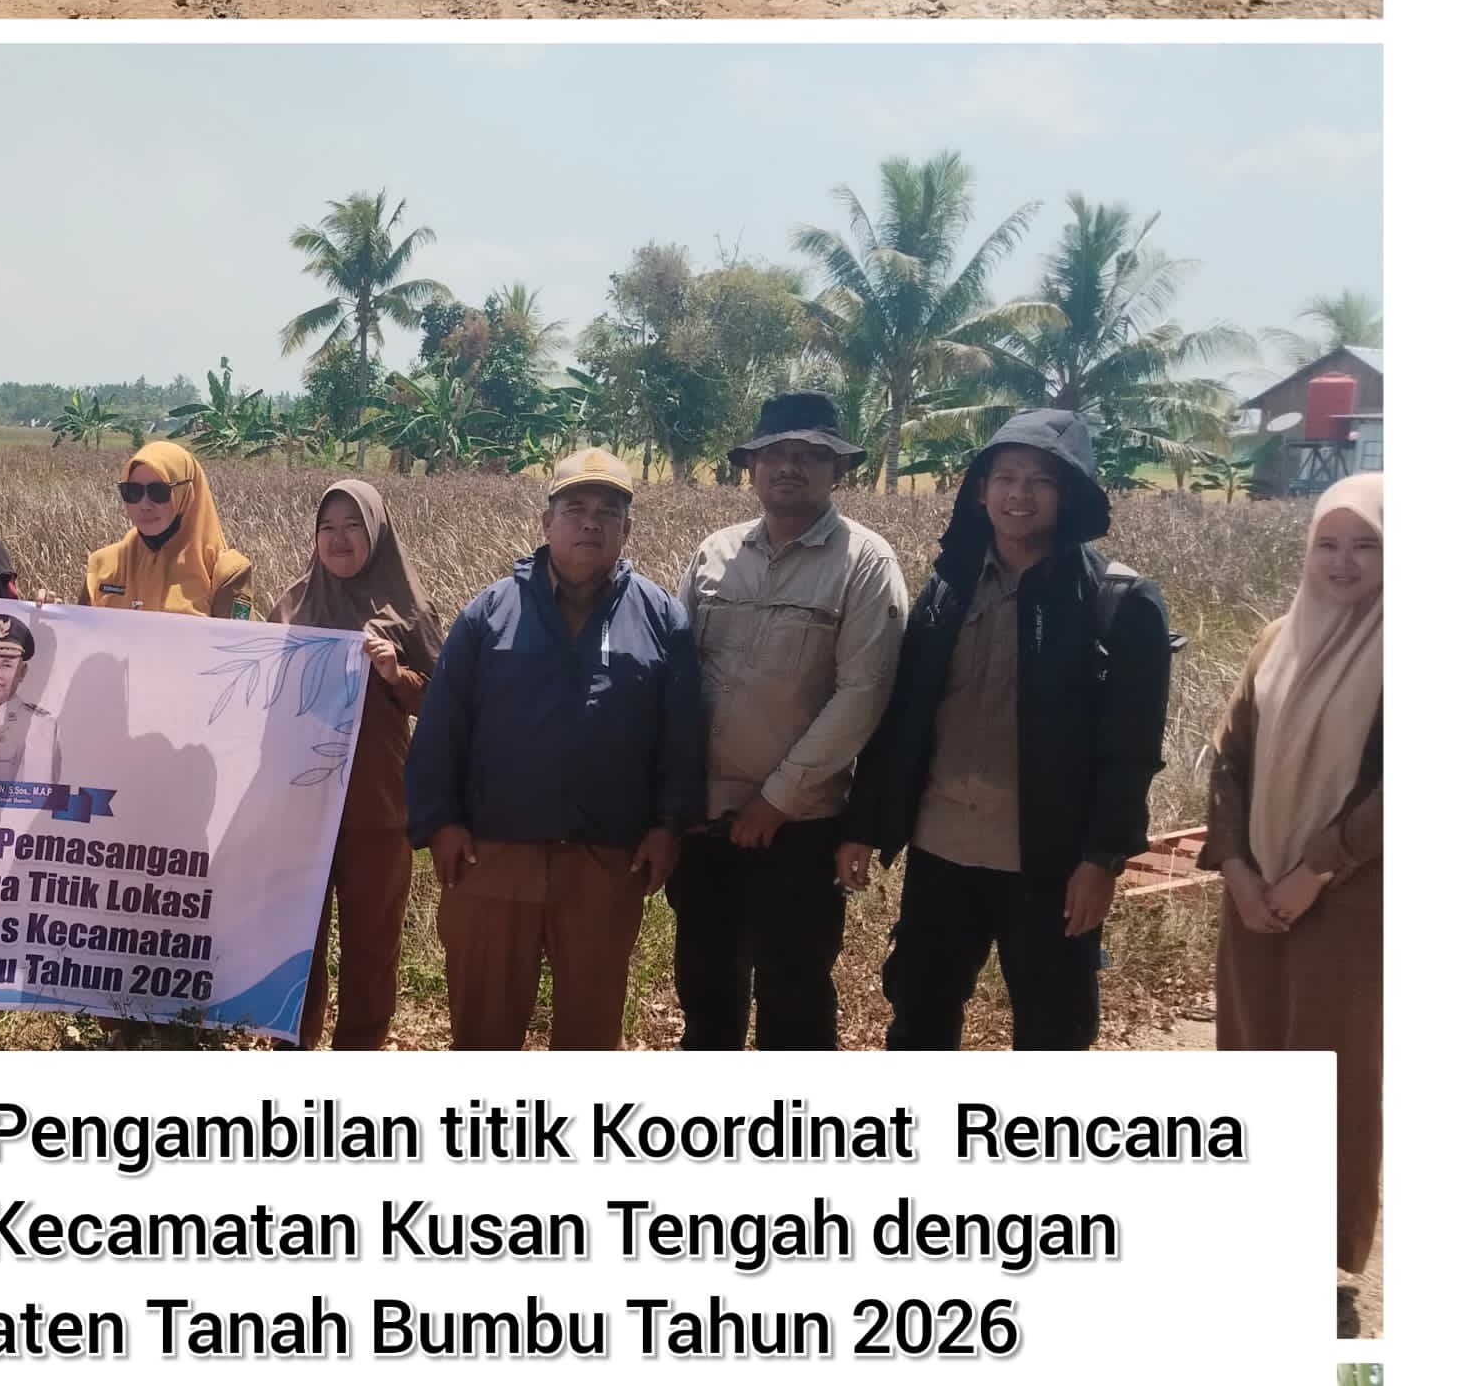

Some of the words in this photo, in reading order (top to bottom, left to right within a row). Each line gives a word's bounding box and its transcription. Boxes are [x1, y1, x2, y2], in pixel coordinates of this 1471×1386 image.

[29, 871, 99, 909] Titik
[106, 879, 213, 919] Lokasi
[26, 913, 212, 961] Kecamatan
[25, 953, 123, 992] Tahun
[129, 964, 213, 1001] 2026
